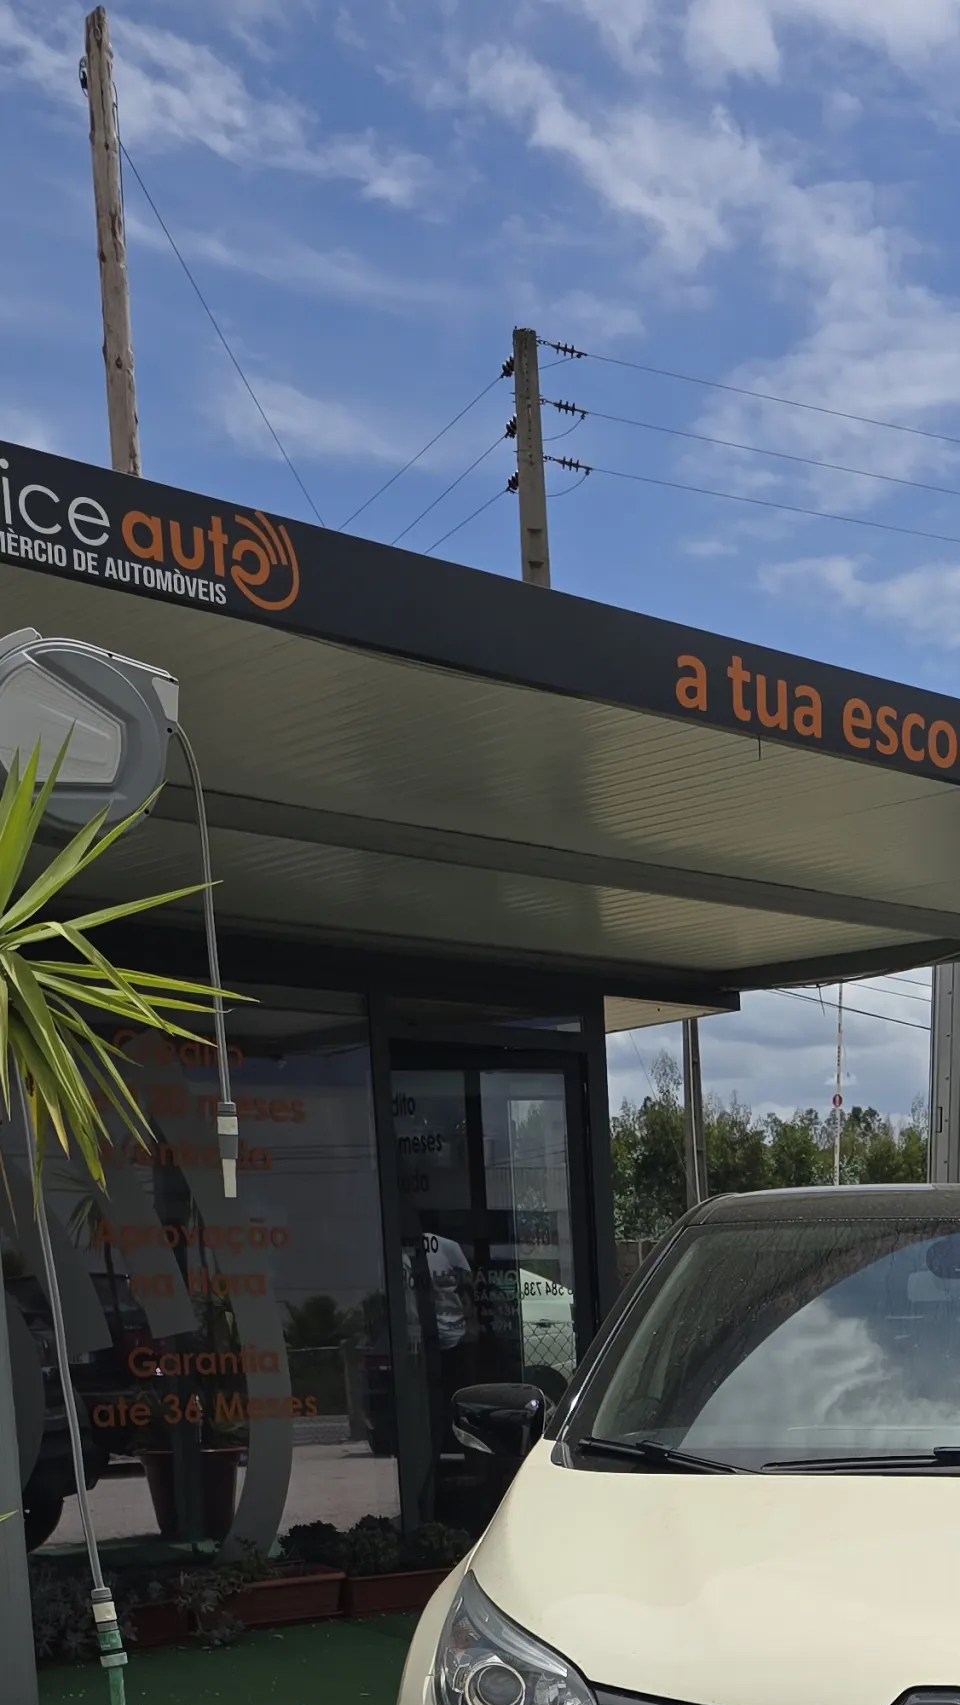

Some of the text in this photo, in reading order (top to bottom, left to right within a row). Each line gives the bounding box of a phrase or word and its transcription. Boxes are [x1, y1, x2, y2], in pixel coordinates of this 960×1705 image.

[73, 548, 100, 576] DE
[121, 510, 300, 611] auto
[675, 654, 708, 712] a
[727, 655, 823, 739] tua
[91, 1217, 292, 1257] Aprovação
[187, 1266, 267, 1298] Hora
[128, 1344, 280, 1378] Garantia
[92, 1391, 318, 1428] até 36 Meses
